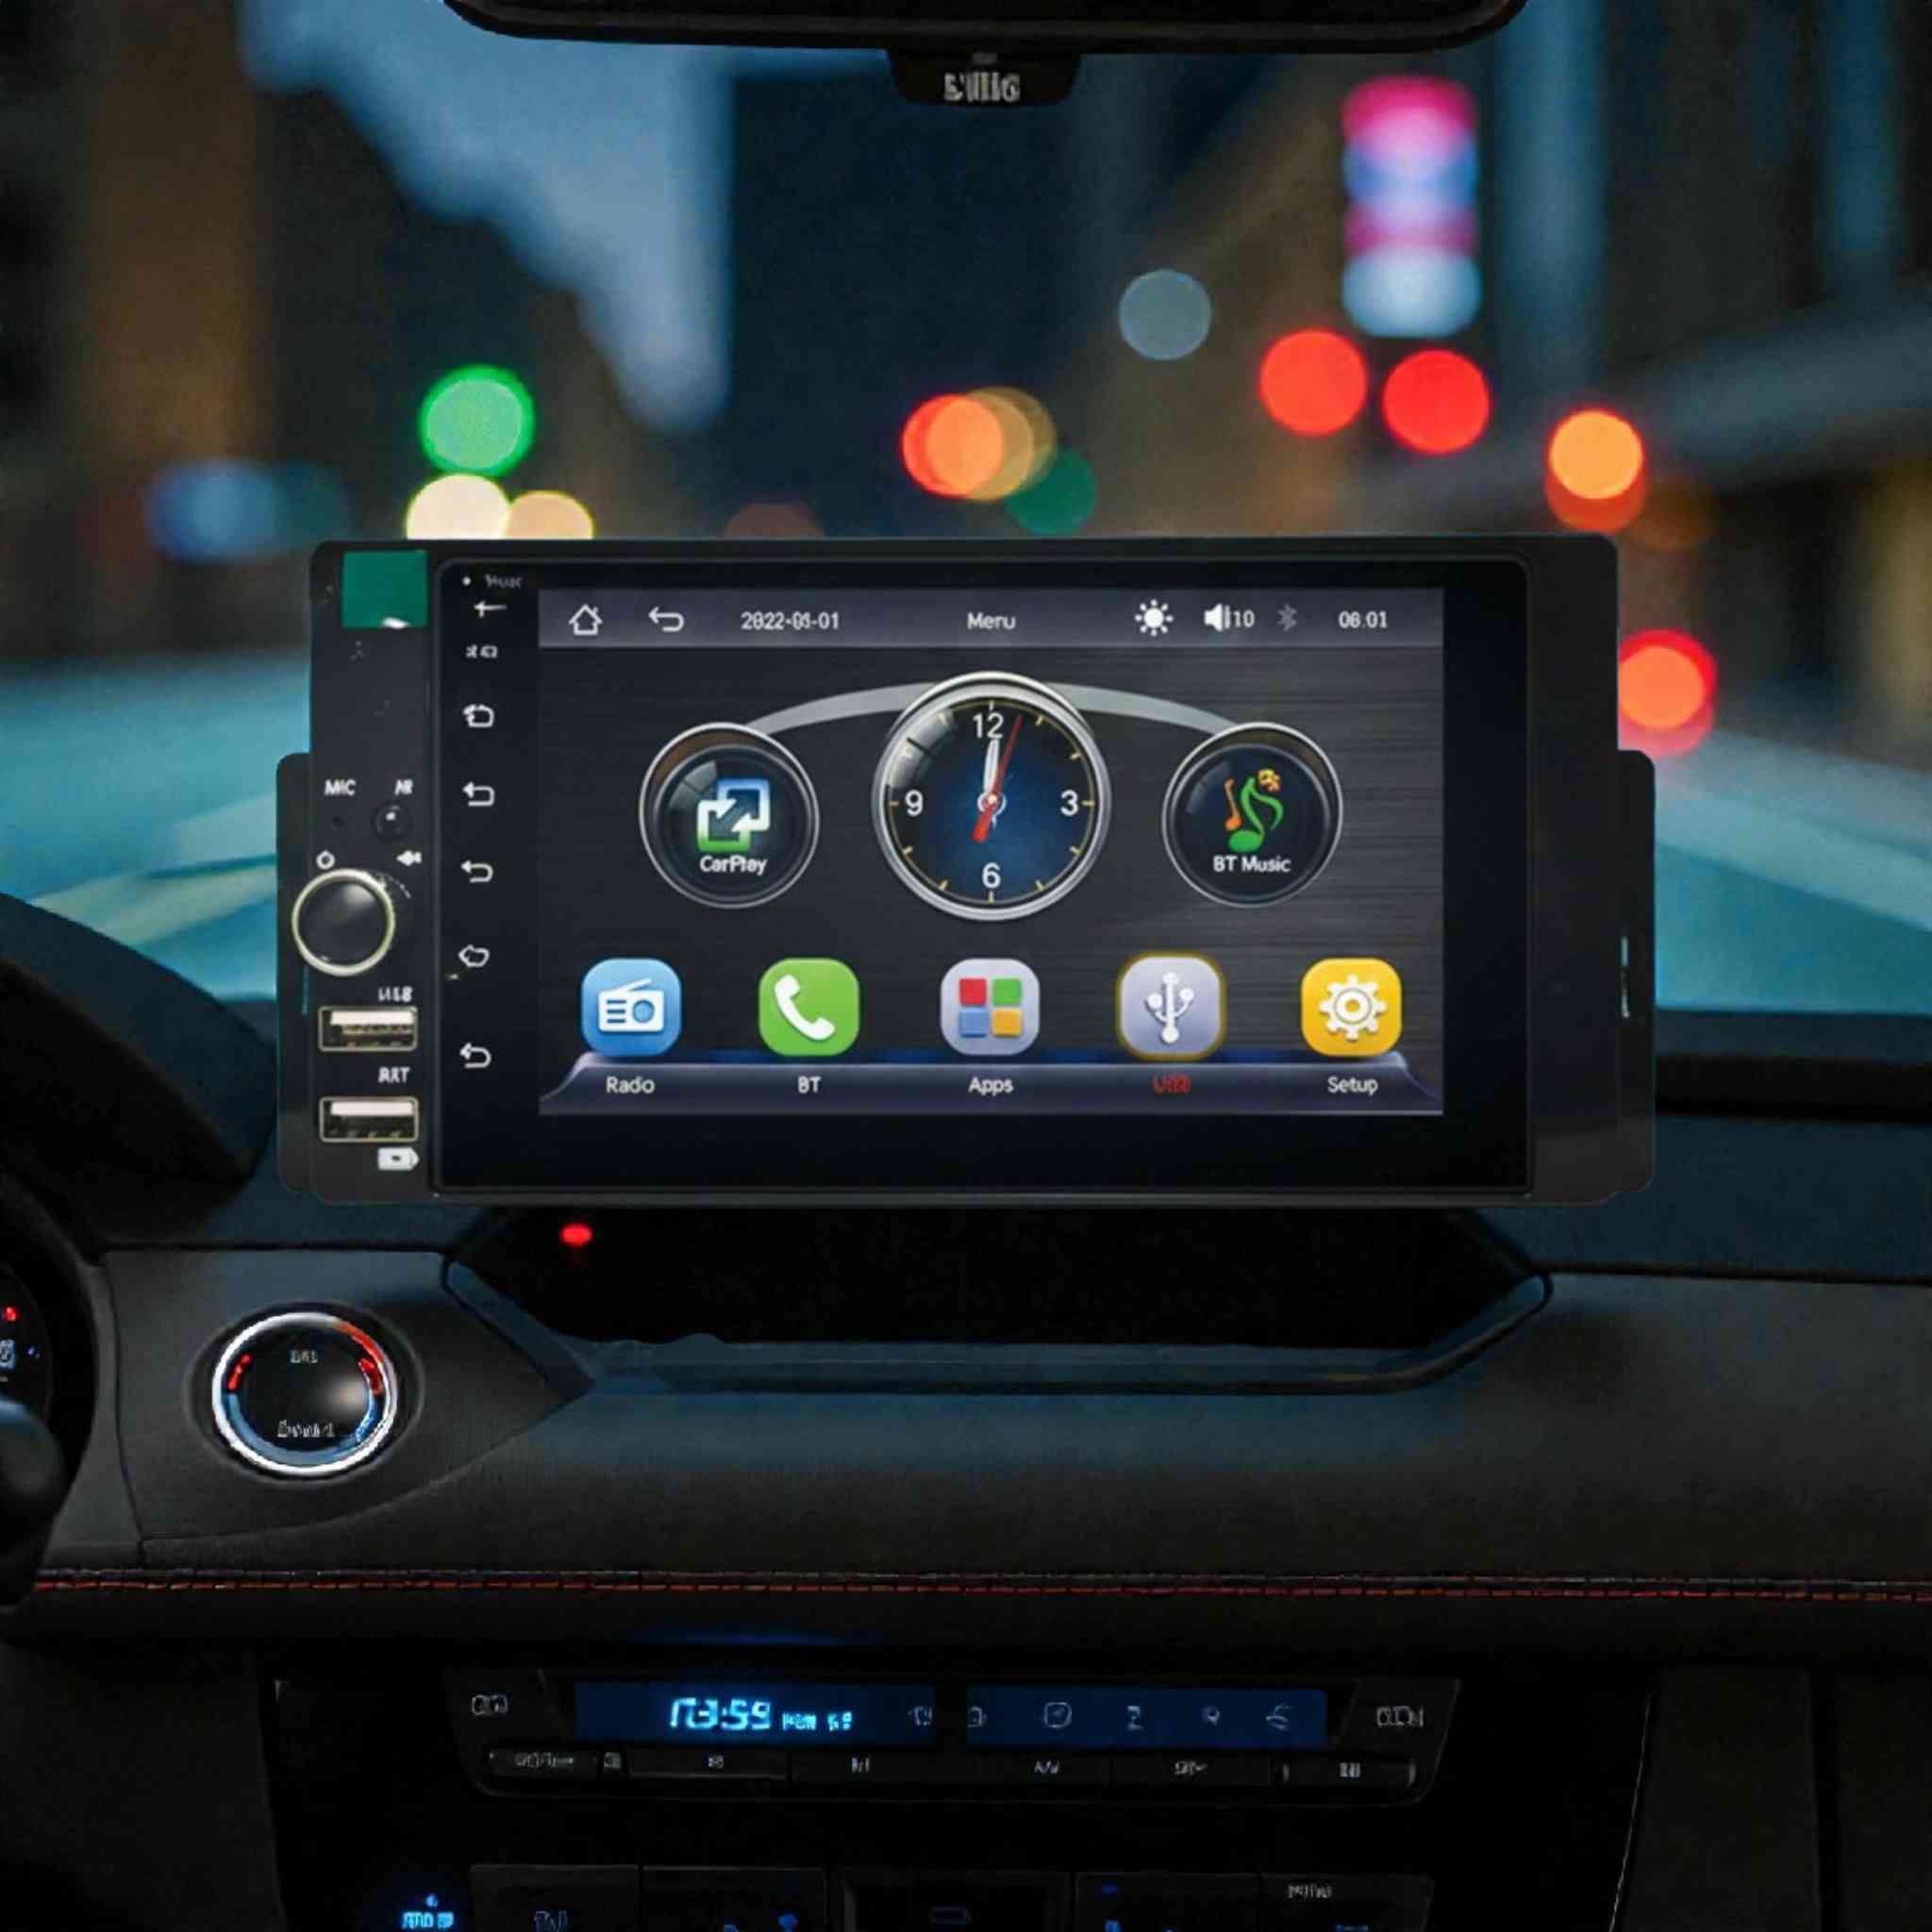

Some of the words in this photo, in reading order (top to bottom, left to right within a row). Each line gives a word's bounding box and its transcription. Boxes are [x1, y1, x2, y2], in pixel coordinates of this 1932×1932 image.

[1233, 609, 1256, 628] 10
[973, 712, 1004, 739] 12
[904, 789, 924, 817] 9
[1059, 790, 1079, 816] 3
[699, 854, 769, 876] CarPlay
[1212, 855, 1238, 872] BT
[1241, 854, 1291, 873] Music
[981, 862, 1001, 889] 6
[797, 1075, 822, 1093] BT
[968, 1075, 1014, 1097] Apps
[1326, 1074, 1379, 1097] Setup
